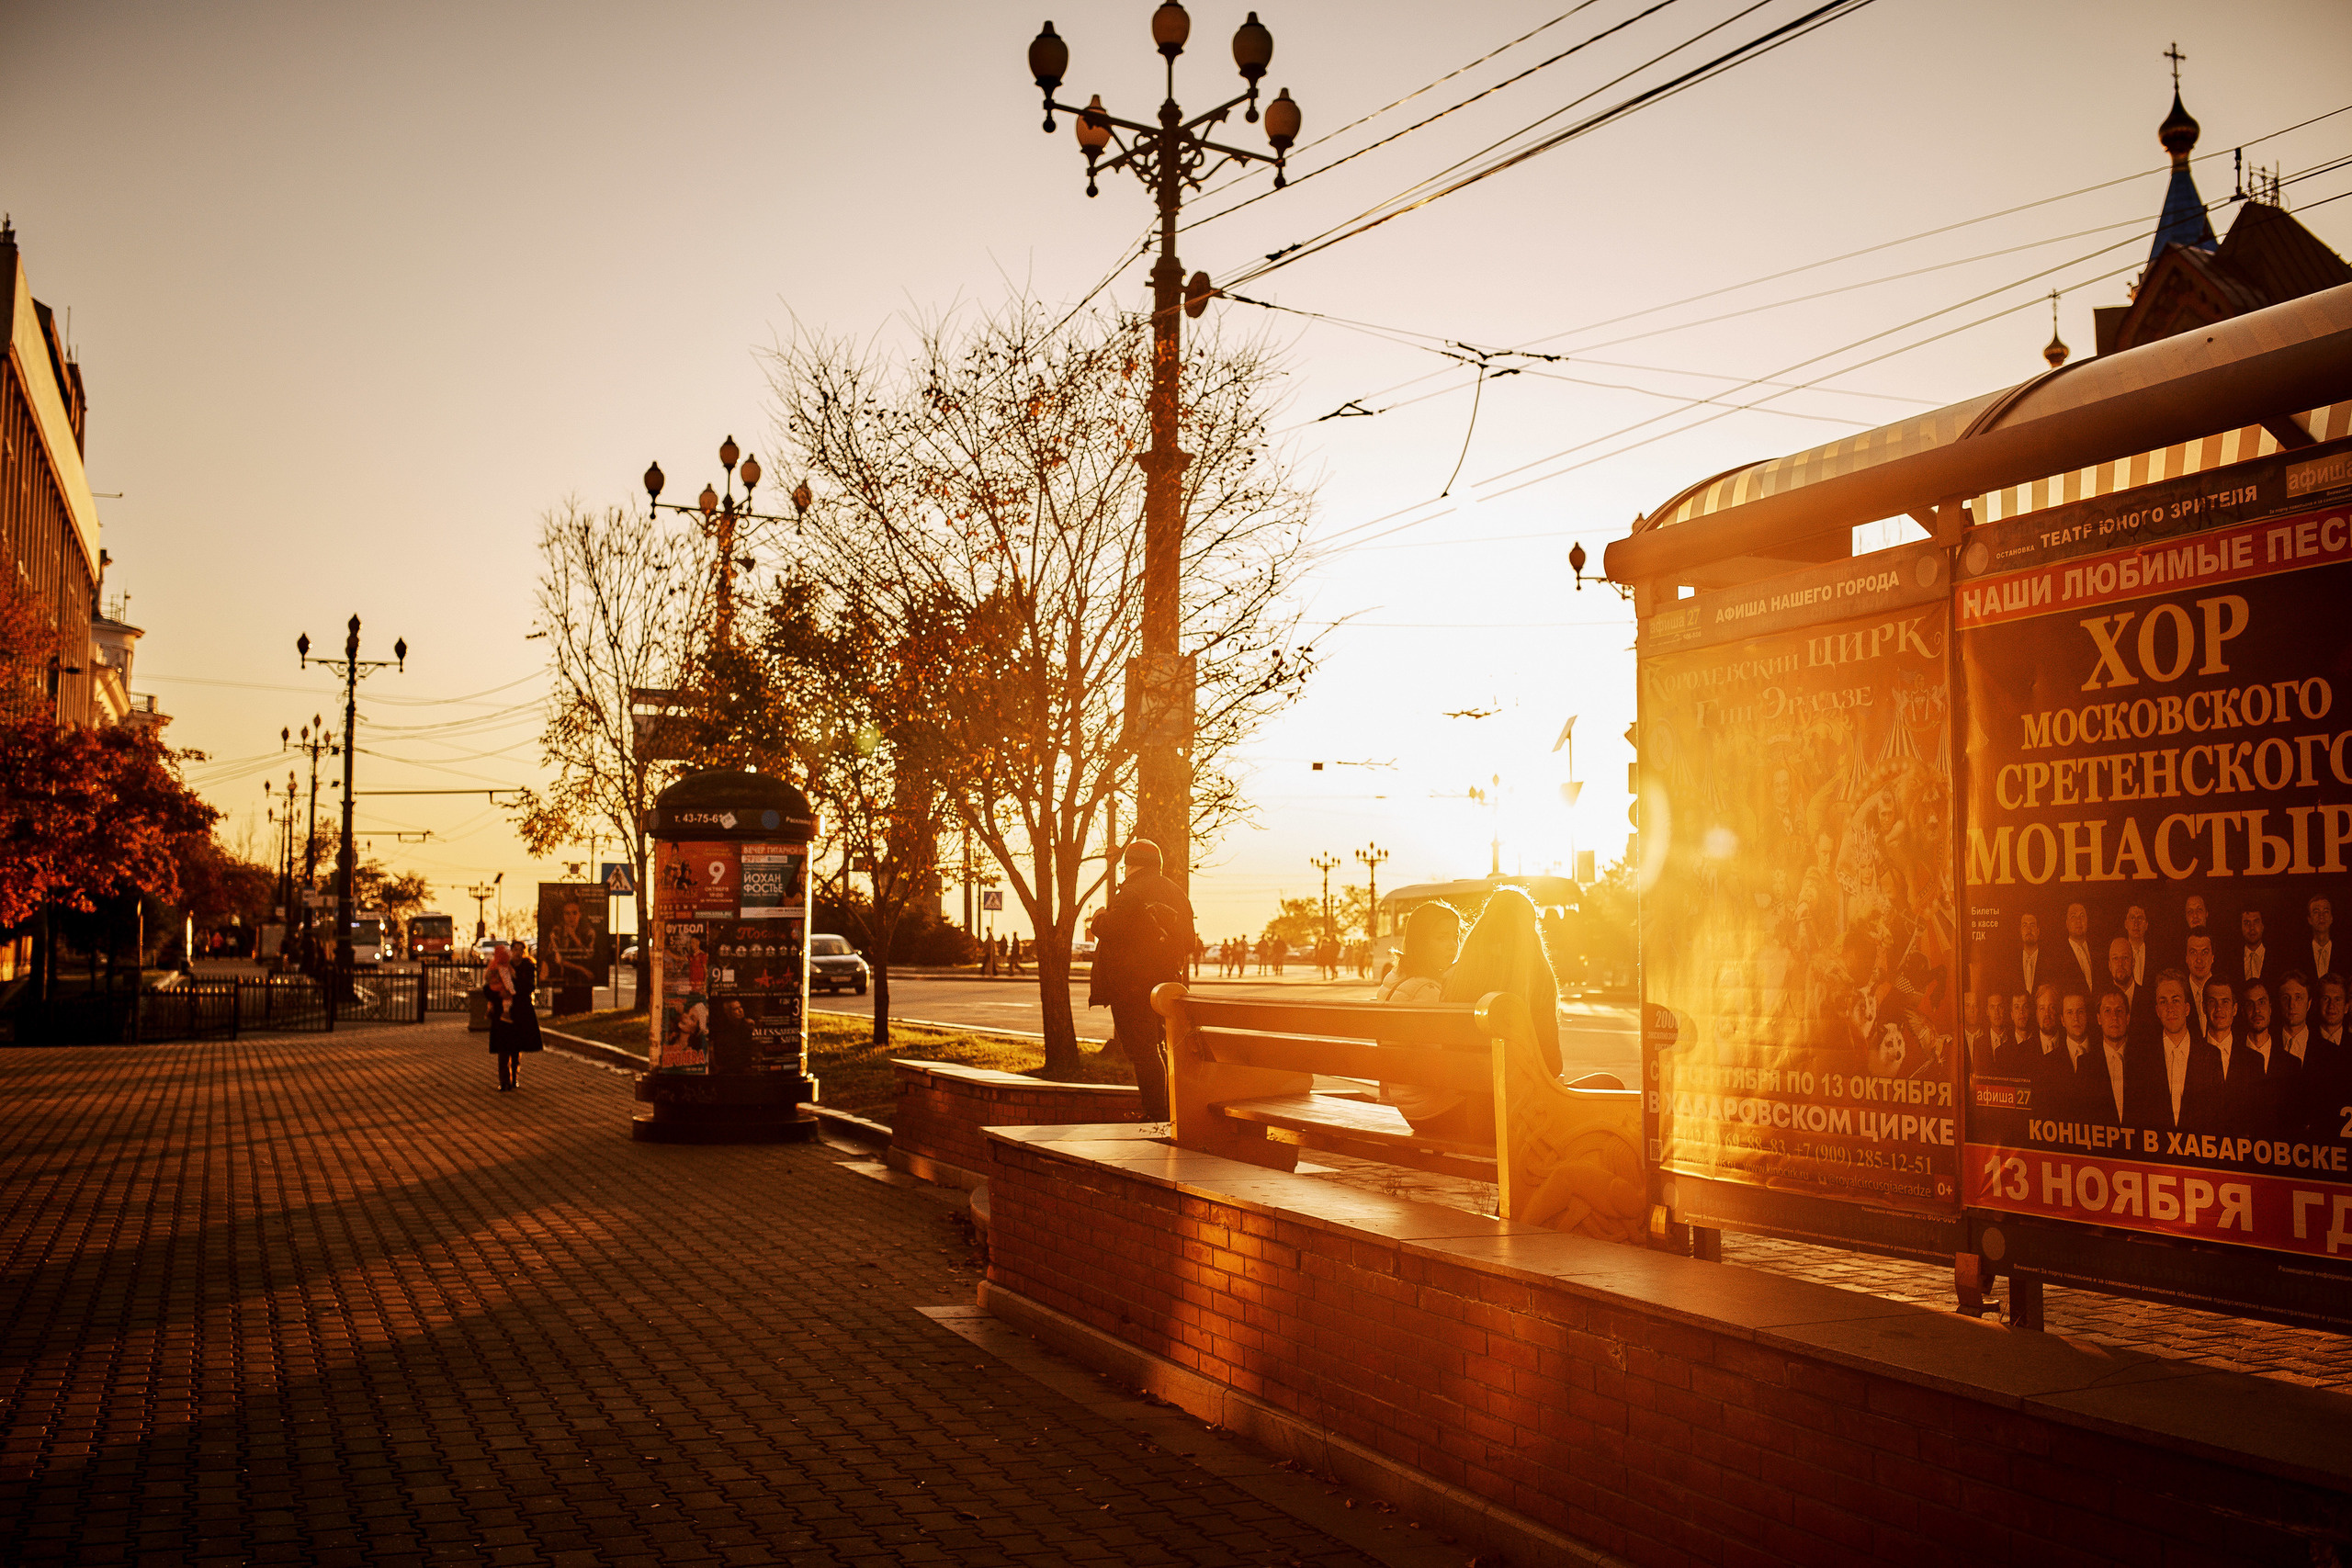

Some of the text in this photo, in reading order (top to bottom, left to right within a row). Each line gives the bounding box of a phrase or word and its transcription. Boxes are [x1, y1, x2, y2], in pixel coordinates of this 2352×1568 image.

[1996, 485, 2258, 560] ОСТАНОВКА ТЕАТР ЮНОГО ЗРИТЕЛЯ
[1962, 514, 2352, 621] НАШИ ЛЮБИМЫЕ ПЕС
[1715, 600, 1768, 624] АФИША
[1770, 586, 1832, 613] НАШЕГО
[1837, 570, 1900, 598] ГОРОДА
[1649, 614, 1684, 636] афиша
[1687, 608, 1701, 626] 27
[1807, 616, 1945, 672] ЦИРК
[2080, 593, 2251, 693] ХОР
[2020, 676, 2334, 751] МОСКОВСКОГО
[708, 861, 726, 886] 9
[743, 871, 782, 885] ЙОХАН
[743, 883, 784, 895] ФОСТЬЕ
[1971, 906, 2000, 917] Билеты
[1979, 919, 1999, 929] кассе
[666, 923, 704, 935] ФУТБОЛ
[1972, 931, 1986, 942] ГДК
[711, 967, 722, 983] 9
[792, 998, 800, 1017] 3
[1650, 1059, 1659, 1082] С
[1787, 1070, 1815, 1096] ПО
[1821, 1072, 1844, 1098] 13
[1849, 1075, 1953, 1108] ОКТЯБРЯ
[1976, 1085, 2031, 1105] афиша 27
[1648, 1091, 1955, 1147] В ХАБАРОВСКОМ ЦИРКЕ
[1794, 1142, 1812, 1160] +7
[1815, 1143, 1853, 1168] (909)
[1856, 1149, 1933, 1176] 285-12-51
[2028, 1118, 2348, 1172] КОНЦЕРТ В ХАБАРОВСКЕ
[1826, 1173, 1953, 1198] @royalcircusgiaeradze 0+
[1984, 1155, 2030, 1201] 13
[2041, 1161, 2255, 1233] НОЯБРЯ
